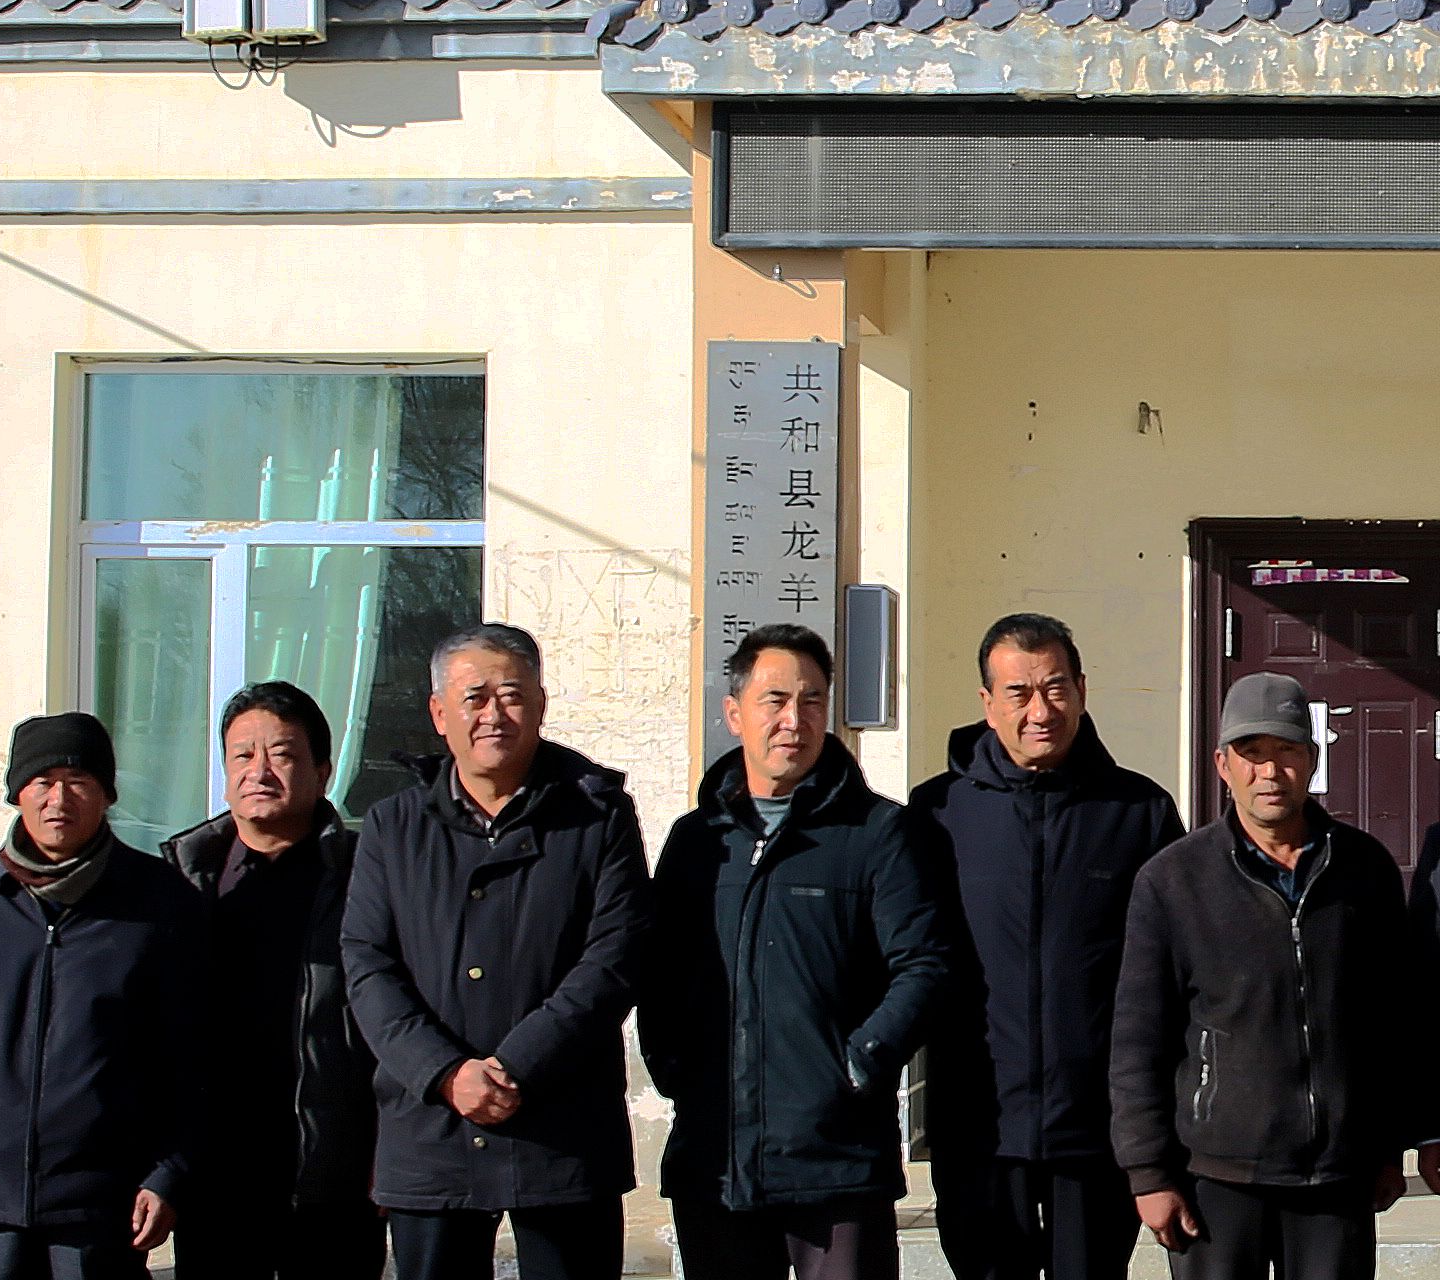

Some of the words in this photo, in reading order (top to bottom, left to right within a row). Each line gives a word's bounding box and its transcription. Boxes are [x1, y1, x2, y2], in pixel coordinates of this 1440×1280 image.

[777, 363, 823, 614] 共和县龙羊
